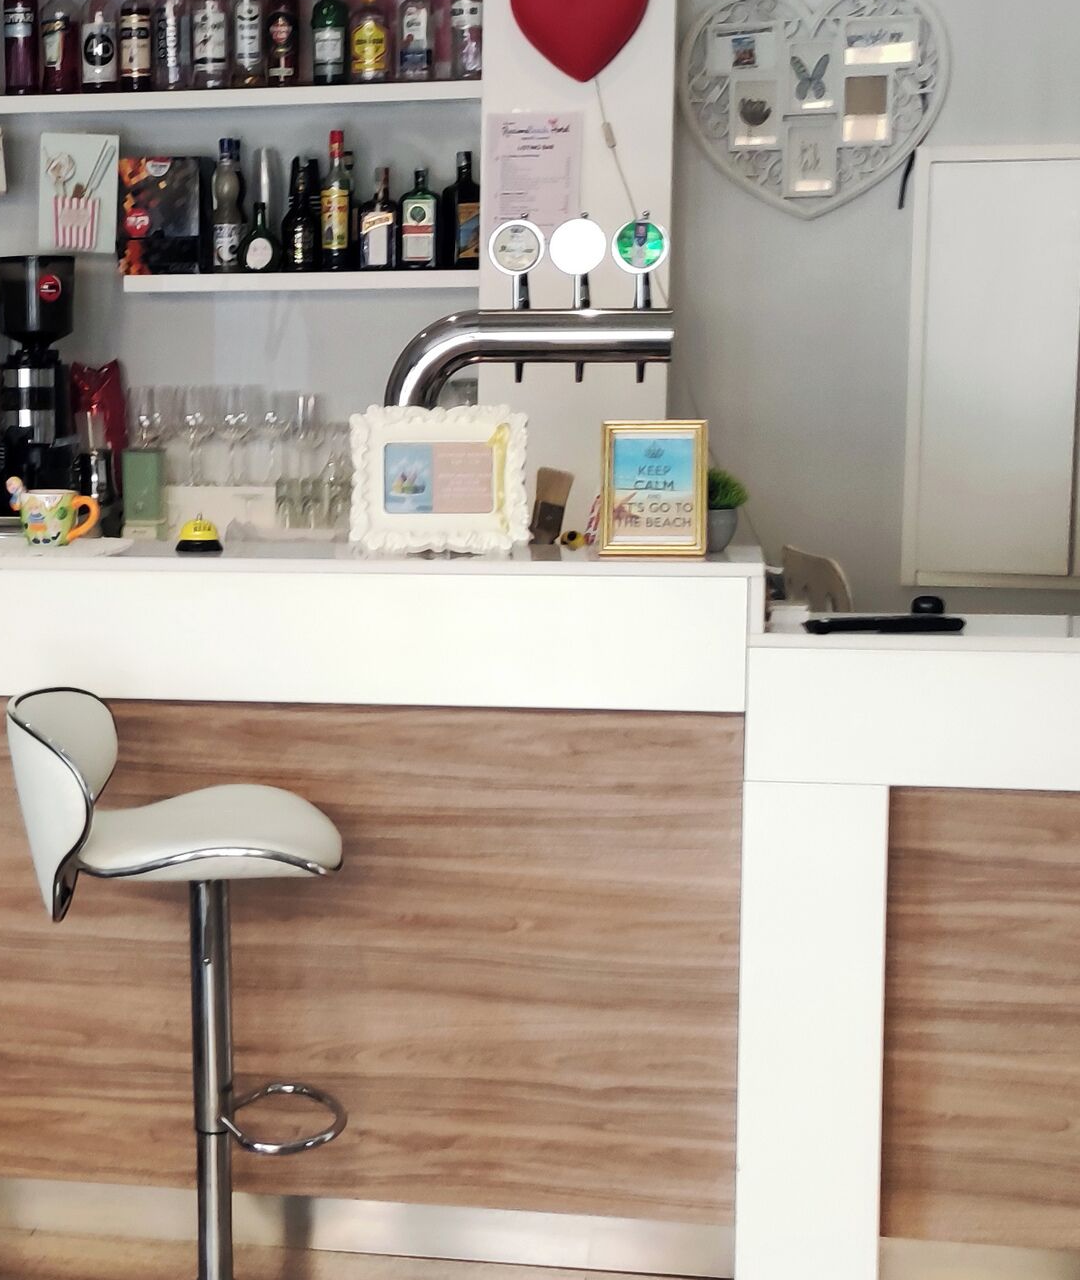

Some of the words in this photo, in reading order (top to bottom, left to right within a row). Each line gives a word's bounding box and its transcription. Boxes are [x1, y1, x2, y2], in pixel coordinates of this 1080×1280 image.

[637, 465, 672, 476] KEEP
[634, 479, 674, 491] CALM
[649, 502, 670, 513] GO
[675, 502, 694, 513] TO
[645, 516, 692, 528] BEACH
